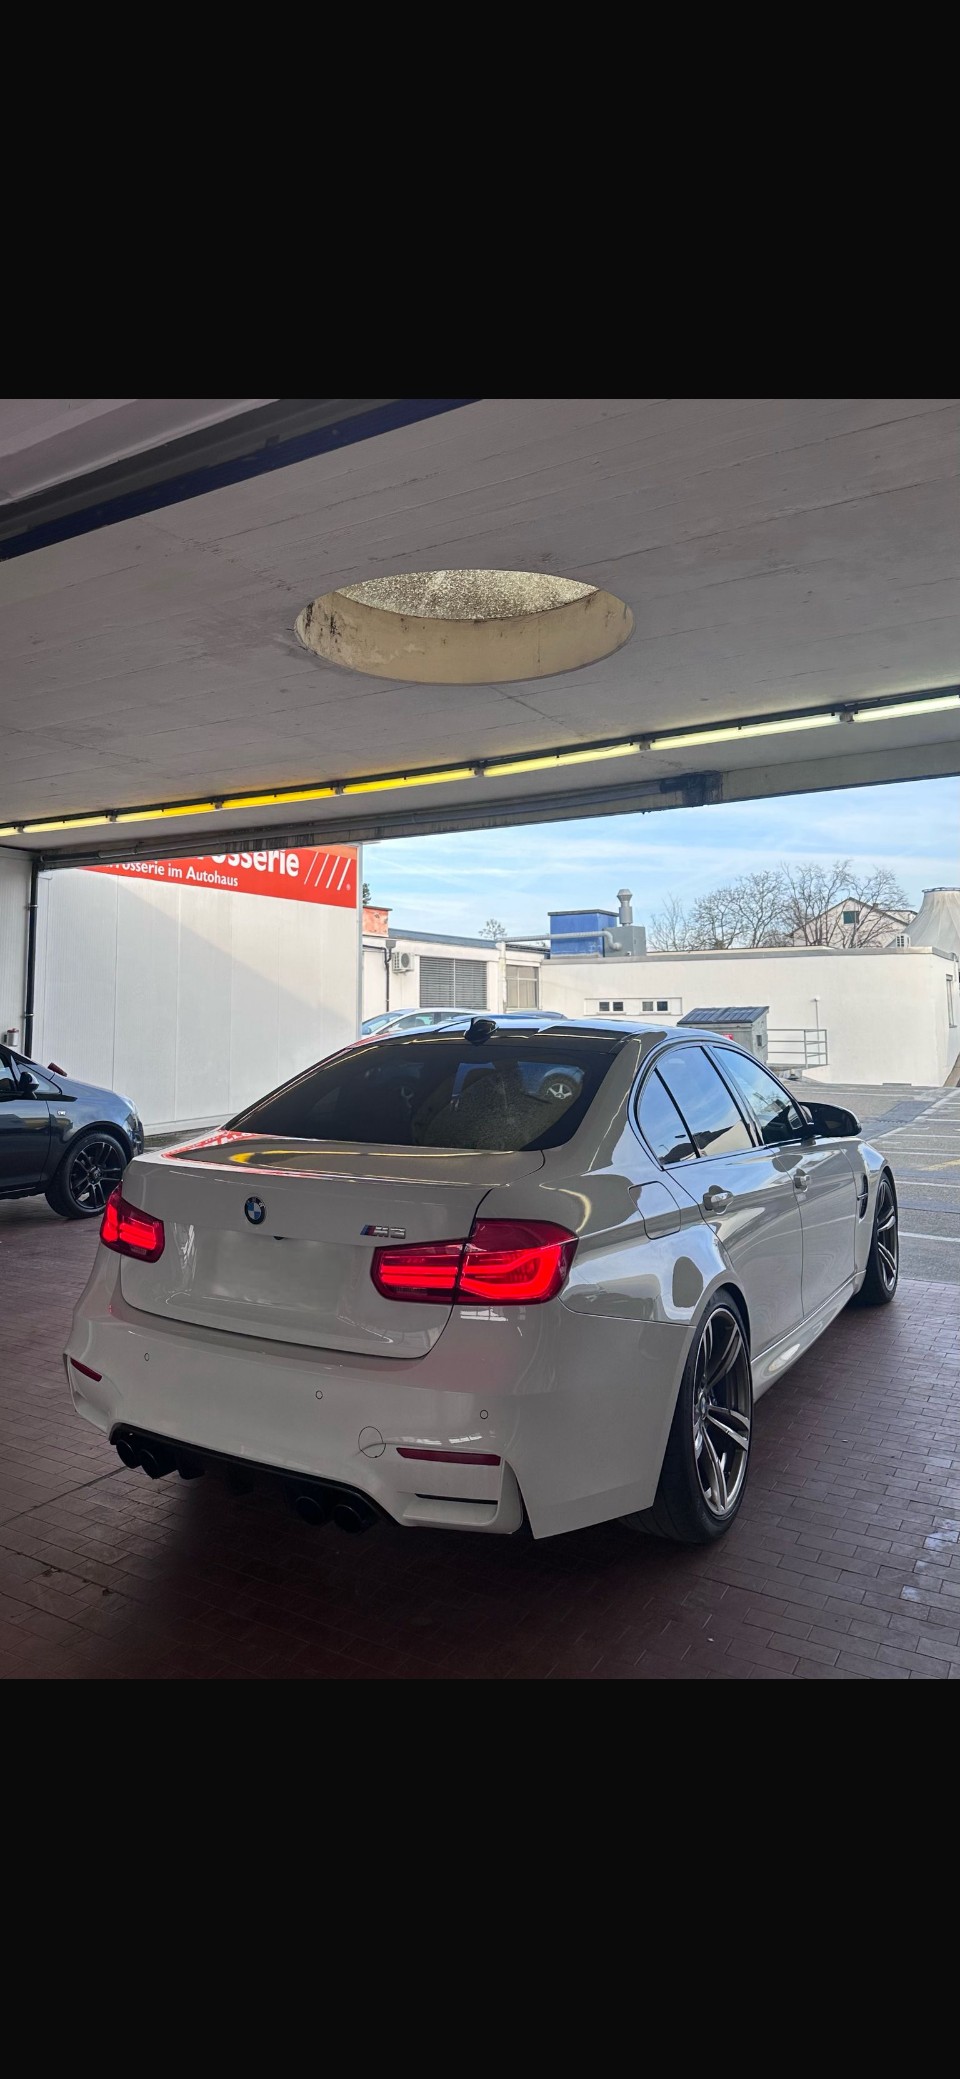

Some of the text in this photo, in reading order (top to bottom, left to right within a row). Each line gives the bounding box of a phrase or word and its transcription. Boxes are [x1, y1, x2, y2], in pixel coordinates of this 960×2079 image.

[106, 861, 239, 887] osserie im Autohaus
[198, 850, 300, 877] osserie
[366, 1225, 406, 1240] M3
